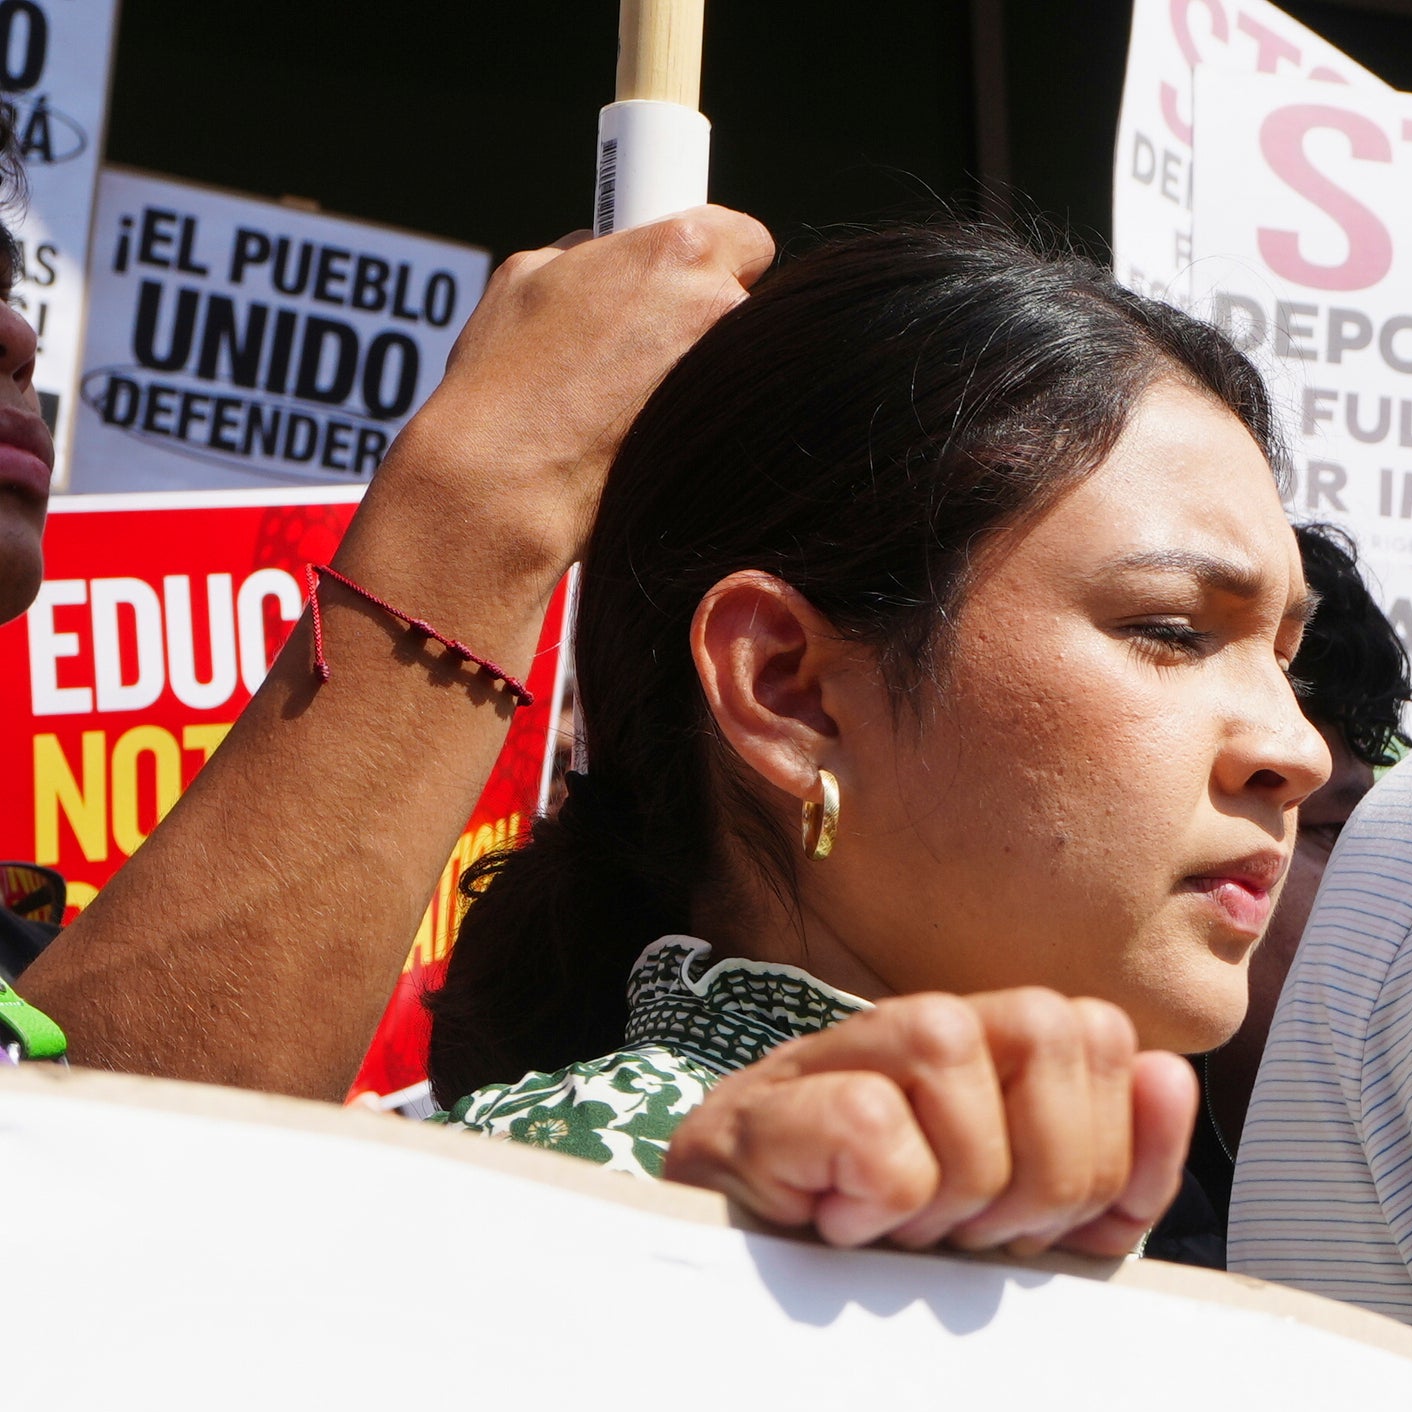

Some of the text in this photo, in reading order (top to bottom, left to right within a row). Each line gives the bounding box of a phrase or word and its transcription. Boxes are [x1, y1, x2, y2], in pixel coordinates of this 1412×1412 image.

[112, 206, 209, 278] ¡EL
[228, 227, 458, 329] PUEBLO
[131, 278, 420, 421] UNIDO
[101, 375, 387, 474] DEFENDER
[29, 567, 307, 716] EDUC
